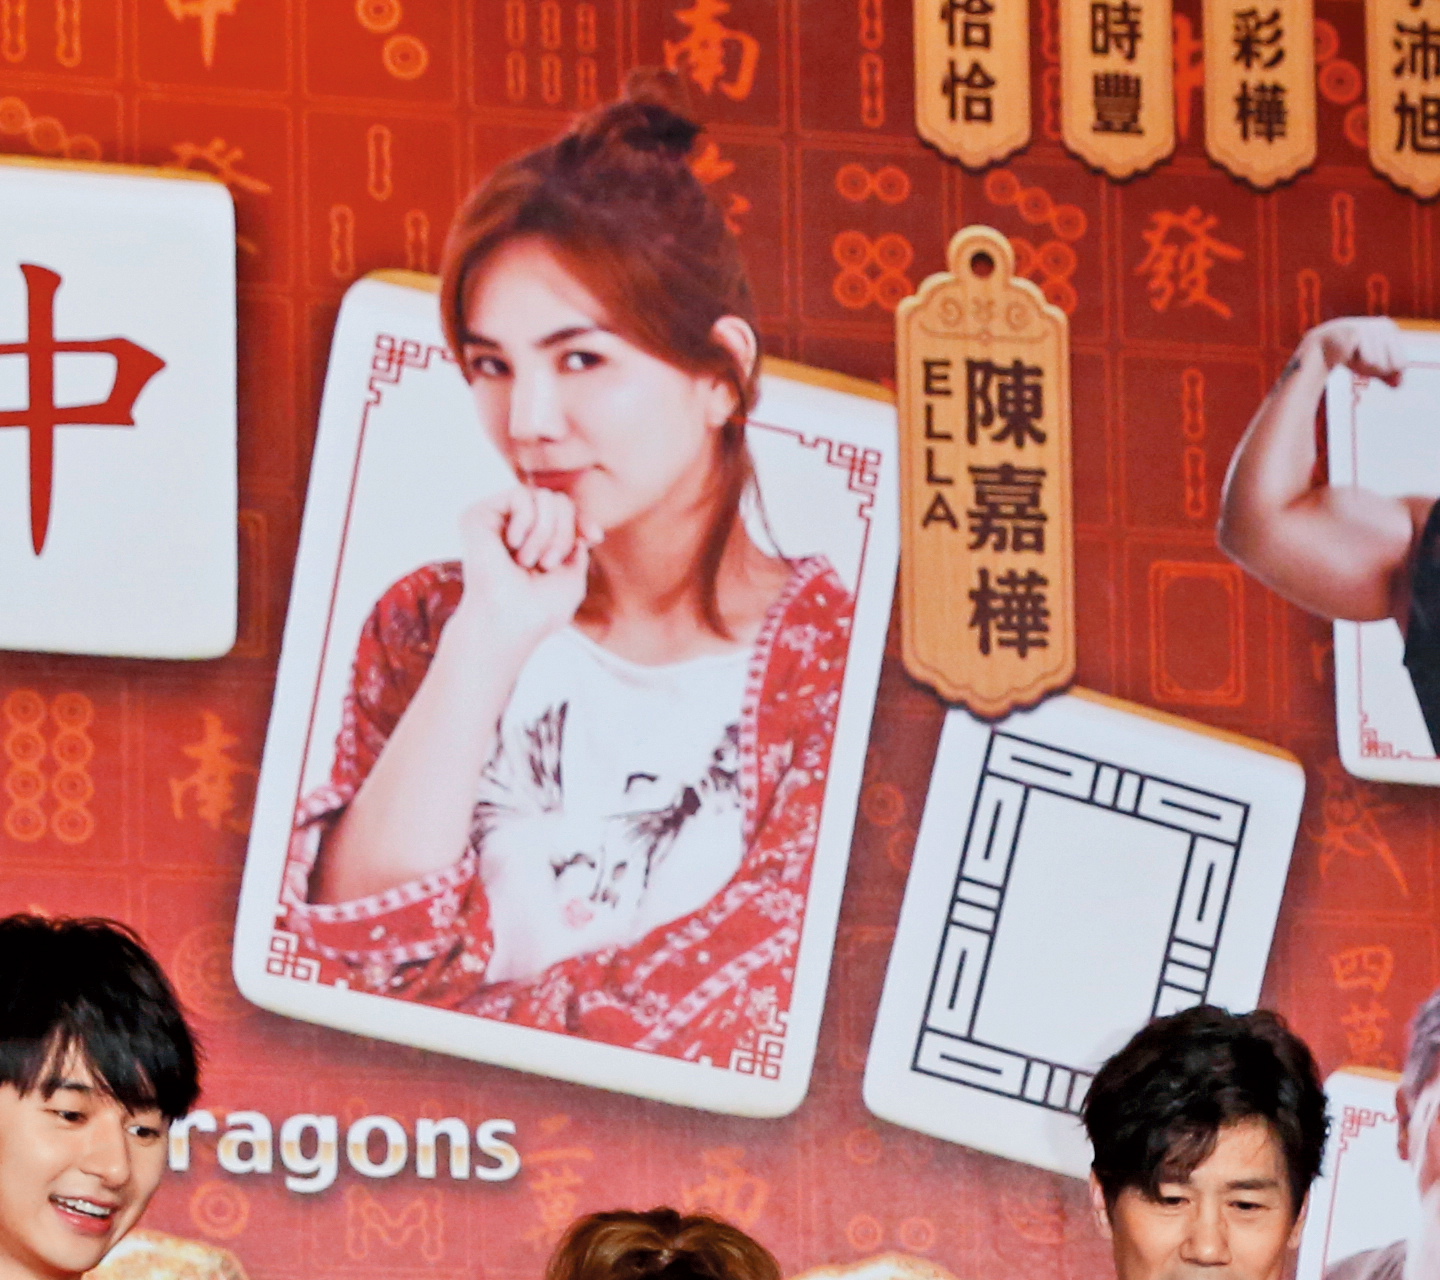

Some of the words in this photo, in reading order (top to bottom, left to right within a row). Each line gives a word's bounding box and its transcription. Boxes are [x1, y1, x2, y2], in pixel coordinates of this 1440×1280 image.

[921, 358, 959, 532] ELLA
[964, 356, 1051, 660] 陳嘉樺
[167, 1108, 523, 1195] ragons
